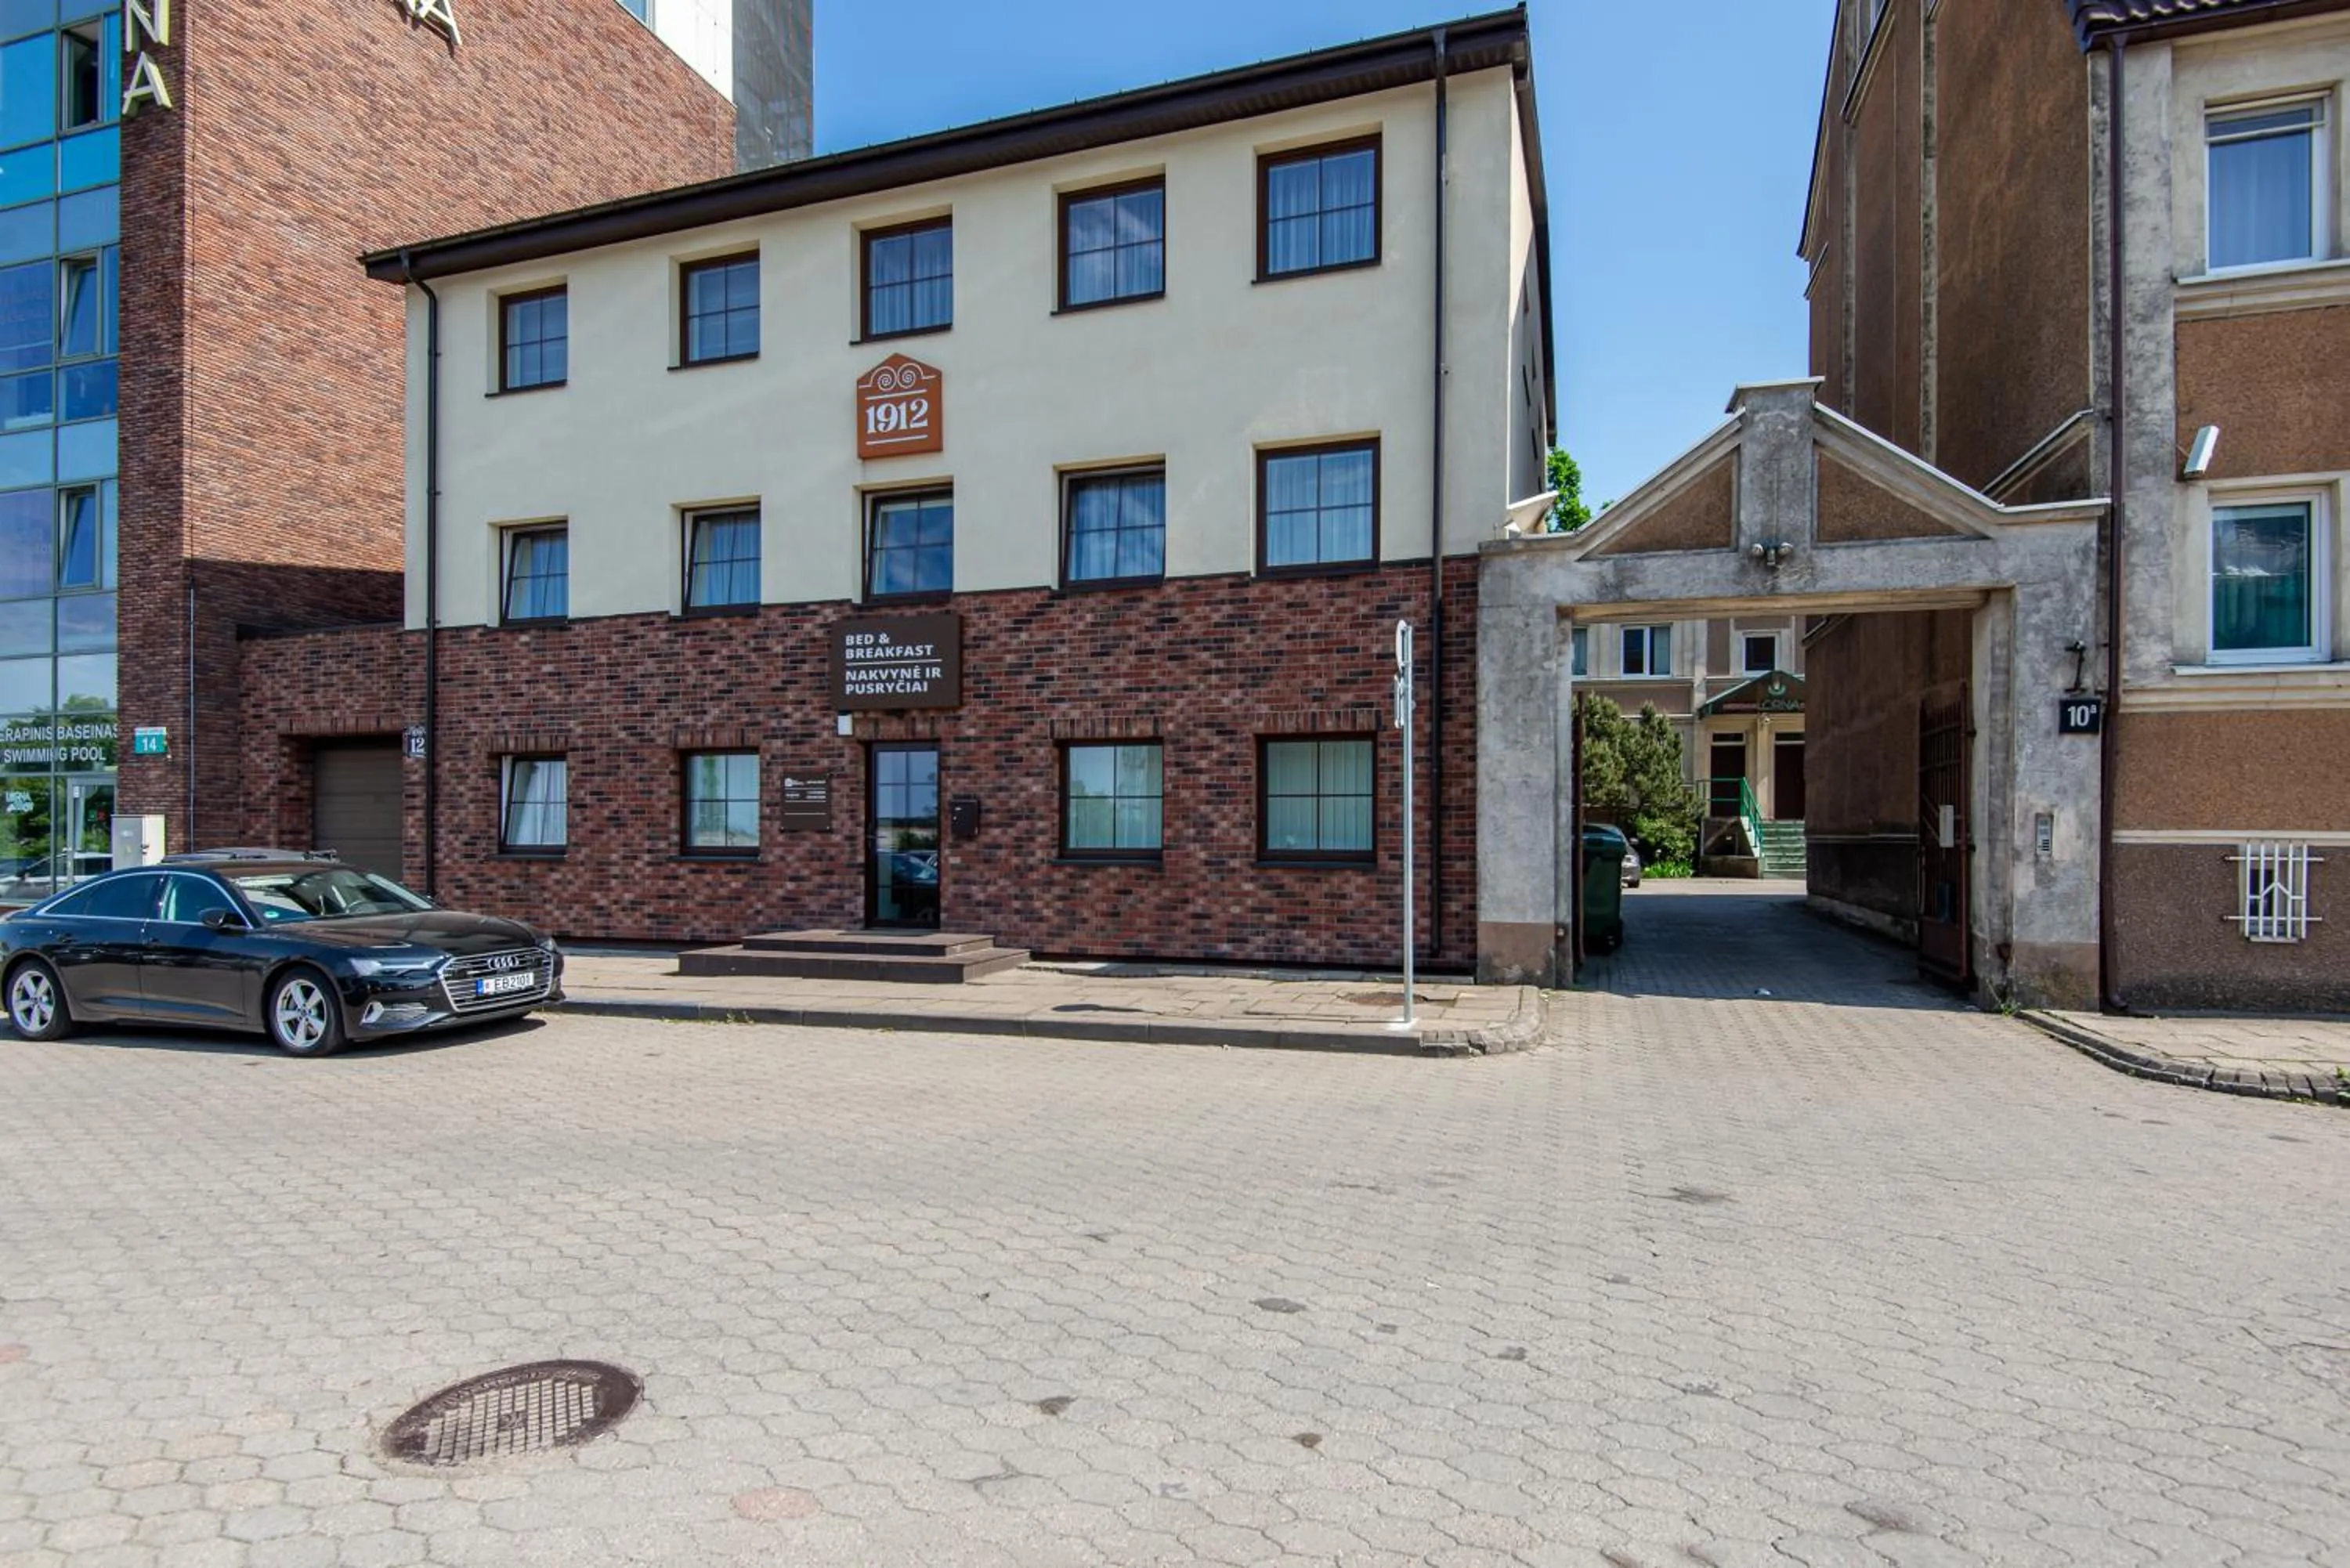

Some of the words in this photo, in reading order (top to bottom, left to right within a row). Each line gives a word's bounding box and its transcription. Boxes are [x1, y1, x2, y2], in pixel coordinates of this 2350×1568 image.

[866, 398, 929, 434] 1912
[845, 634, 874, 646] BED
[878, 632, 891, 645] &
[845, 644, 934, 659] BREAKFAST
[845, 665, 921, 681] NAKVYNĖ
[925, 667, 942, 679] IR
[845, 679, 928, 695] PUSRYČIAI
[143, 736, 157, 752] 14
[410, 737, 425, 753] 12
[71, 746, 107, 761] POOL
